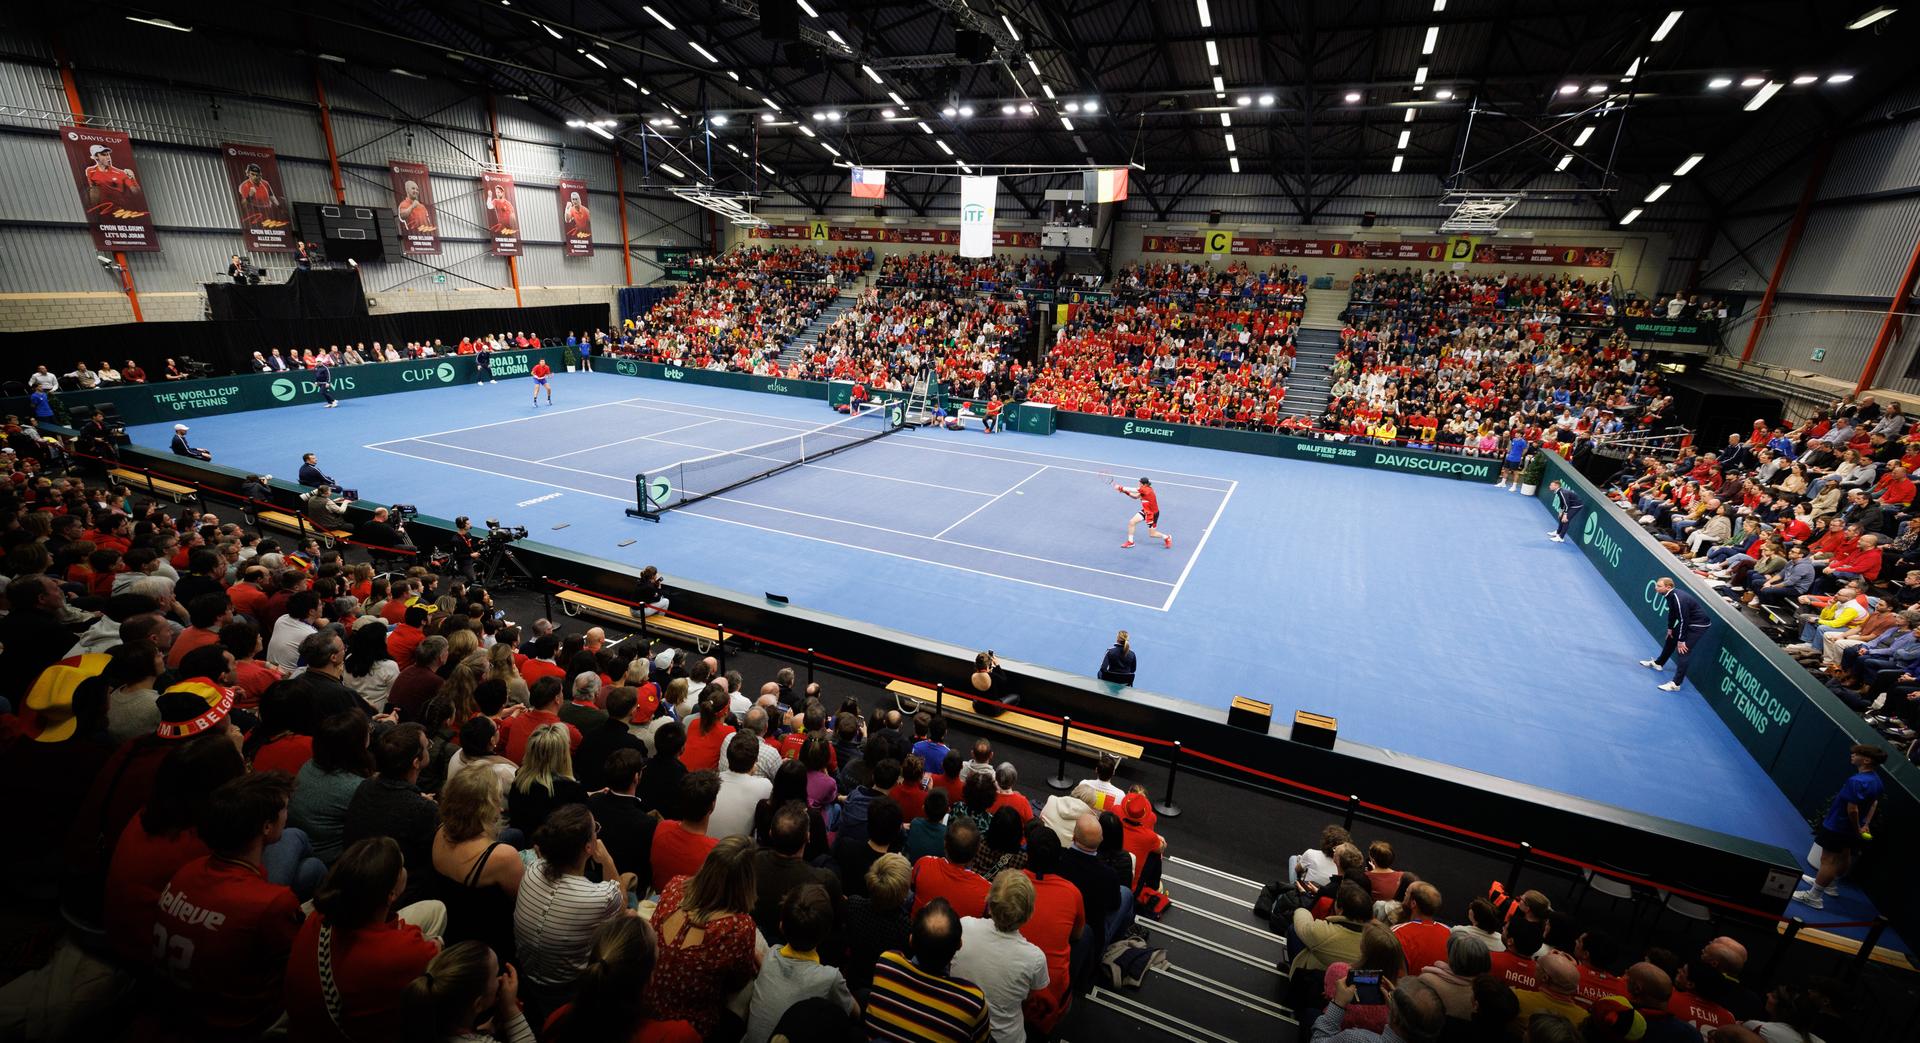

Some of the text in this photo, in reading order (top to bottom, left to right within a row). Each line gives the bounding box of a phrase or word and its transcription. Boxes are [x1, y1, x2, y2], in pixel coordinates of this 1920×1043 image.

[80, 134, 104, 142] DAVIS
[964, 210, 985, 222] ITF
[814, 223, 825, 238] A
[1210, 233, 1226, 252] C
[1452, 239, 1472, 259] D
[1635, 323, 1677, 332] QUALIFIERS
[489, 354, 528, 367] ROAD TO
[402, 367, 434, 383] CUP
[491, 364, 529, 377] BOLOGNA
[301, 376, 356, 394] DVIS
[767, 377, 788, 394] ethias
[154, 386, 239, 403] THE WORLD CUP
[172, 396, 228, 411] OF TENNIS
[1135, 426, 1175, 437] EXPLICIET
[1297, 443, 1357, 457] QUALIFIERS 2025
[1375, 453, 1489, 477] DAVISCUP.COM
[1594, 527, 1622, 568] DAVIS
[1718, 647, 1791, 727] THE WORLD CUP
[195, 688, 235, 730] BELGIU
[1721, 676, 1769, 734] OF TENNIS
[1505, 969, 1536, 988] NACHO
